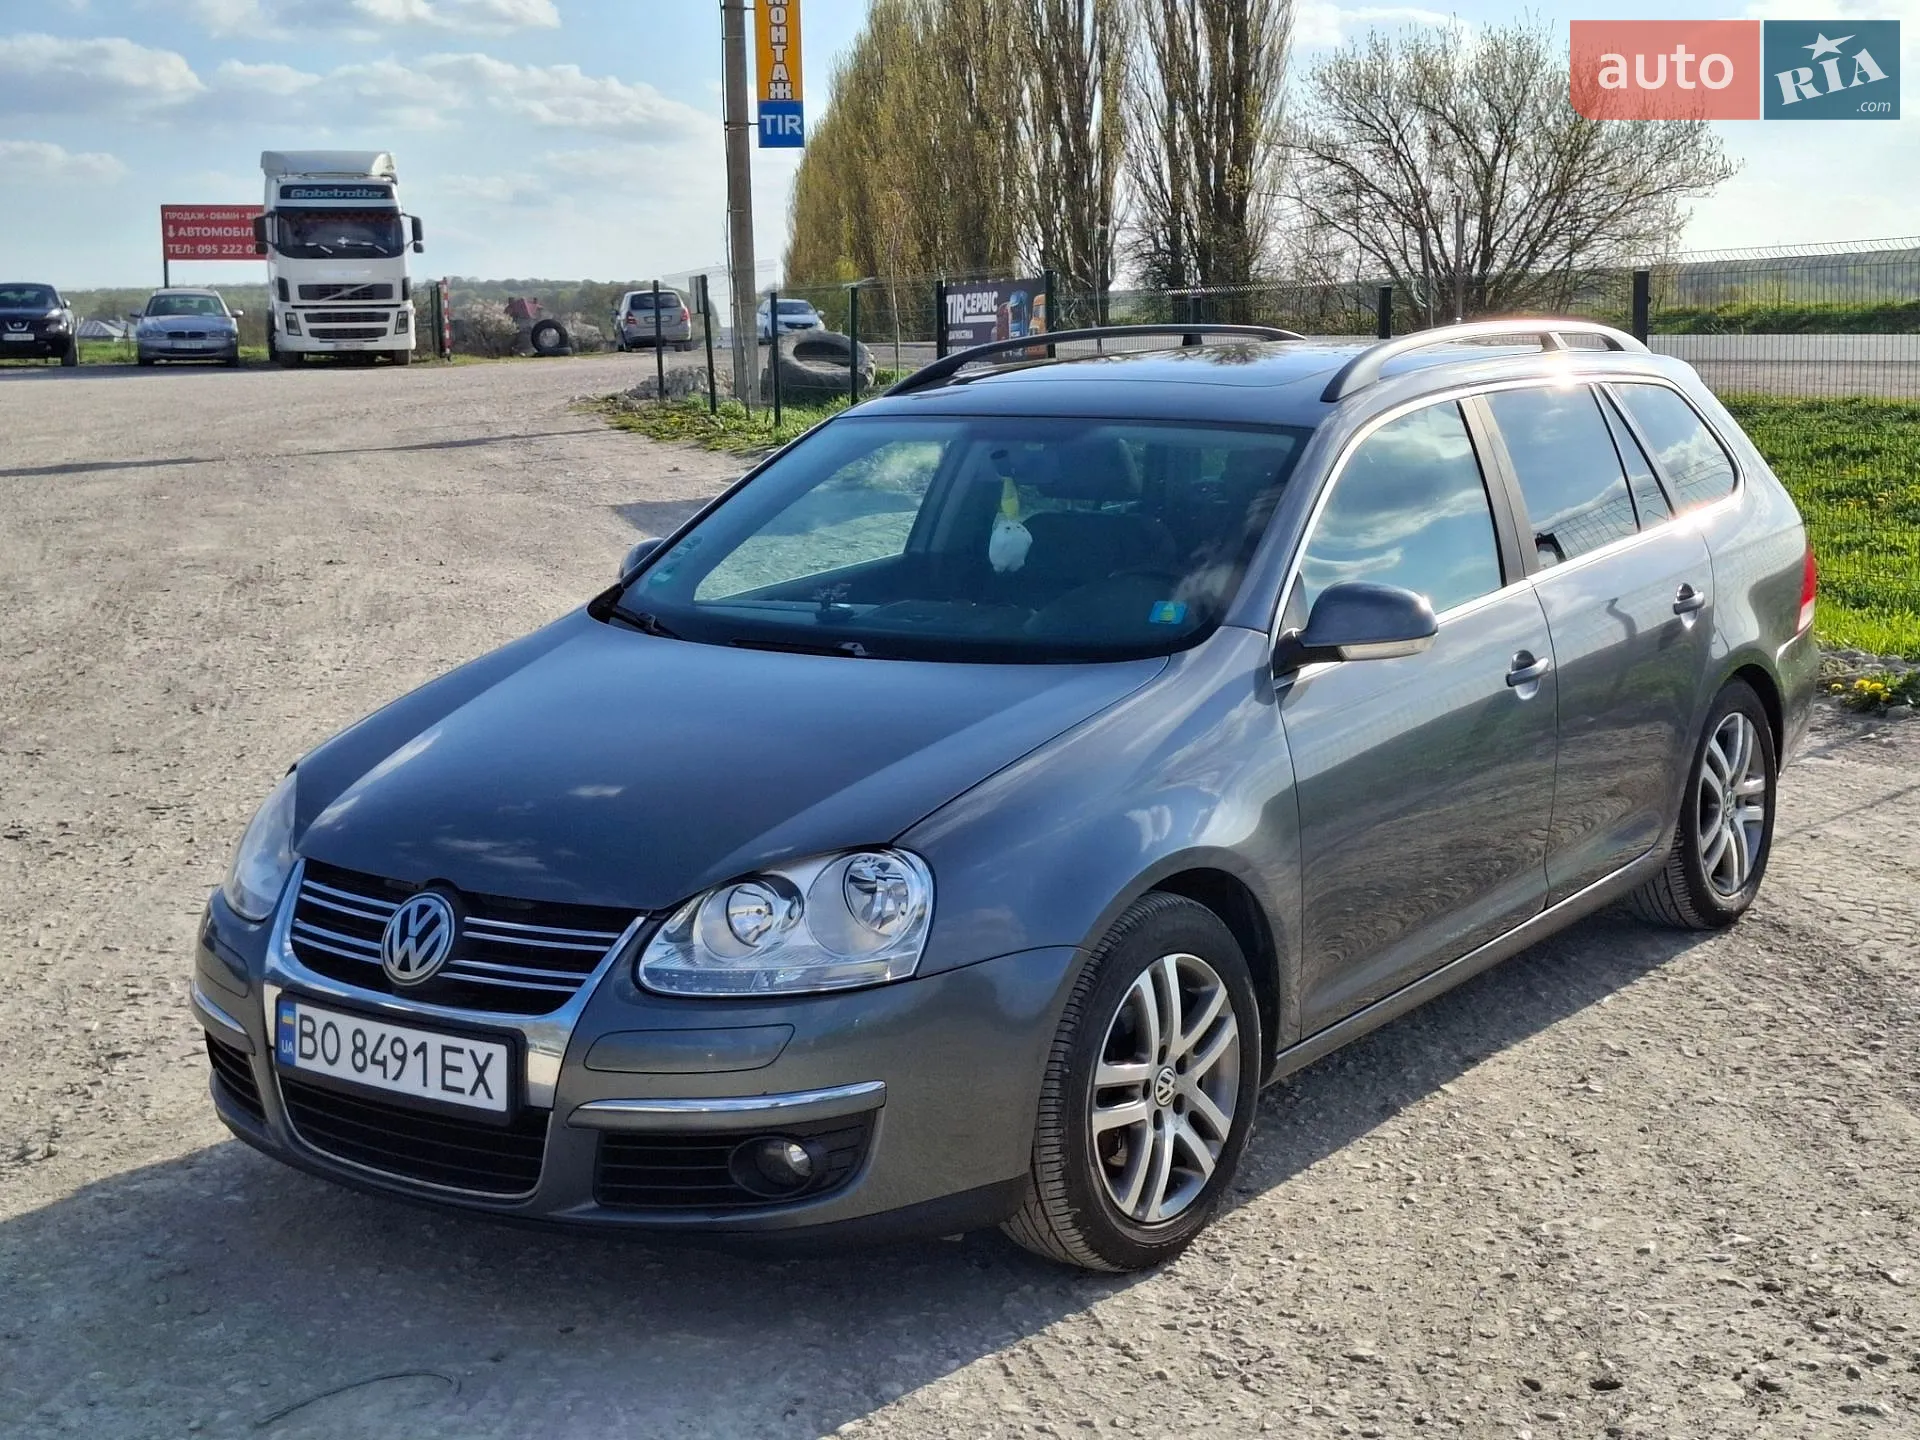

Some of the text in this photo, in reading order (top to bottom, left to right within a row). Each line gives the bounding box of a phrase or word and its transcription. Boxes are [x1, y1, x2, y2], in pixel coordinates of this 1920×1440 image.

[761, 114, 802, 135] TIR
[290, 188, 385, 199] Globetrotter
[165, 211, 205, 221] ПРОДАЖ
[178, 226, 254, 237] АВТОМОБІЛ
[168, 243, 195, 254] ТЕЛ:
[197, 243, 218, 254] 095
[222, 243, 243, 254] 222
[946, 291, 998, 324] TIR СЕРВІС
[281, 1039, 294, 1054] UA
[299, 1014, 494, 1100] BO 8491 EX
